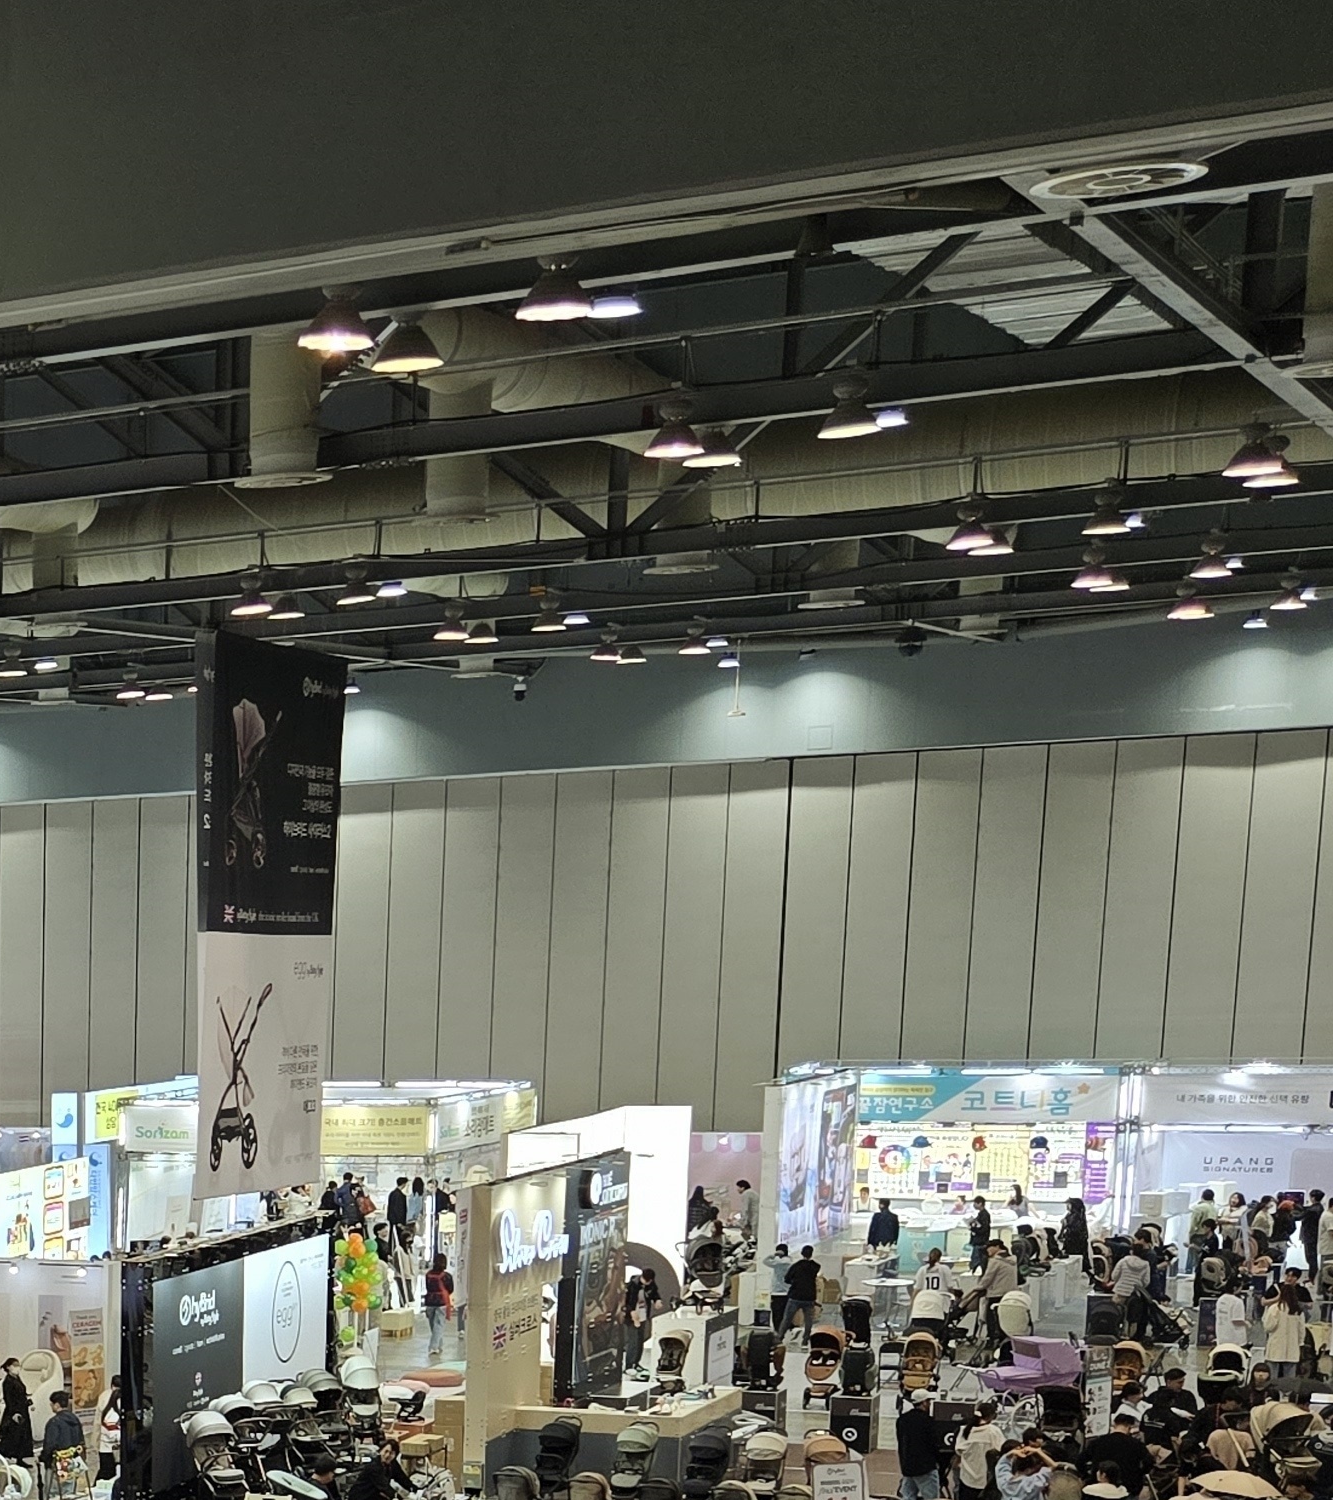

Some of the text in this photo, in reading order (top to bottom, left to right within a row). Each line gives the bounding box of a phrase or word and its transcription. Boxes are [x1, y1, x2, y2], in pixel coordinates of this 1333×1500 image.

[961, 1088, 1074, 1116] 코트니홈
[1176, 1094, 1185, 1104] 내
[1187, 1094, 1215, 1104] 가족을
[1219, 1094, 1237, 1104] 위한
[1239, 1094, 1268, 1105] 안전한
[1269, 1094, 1289, 1105] 선택
[135, 1122, 190, 1139] Sorizam
[1203, 1156, 1275, 1166] UPANG
[925, 1275, 940, 1290] 10
